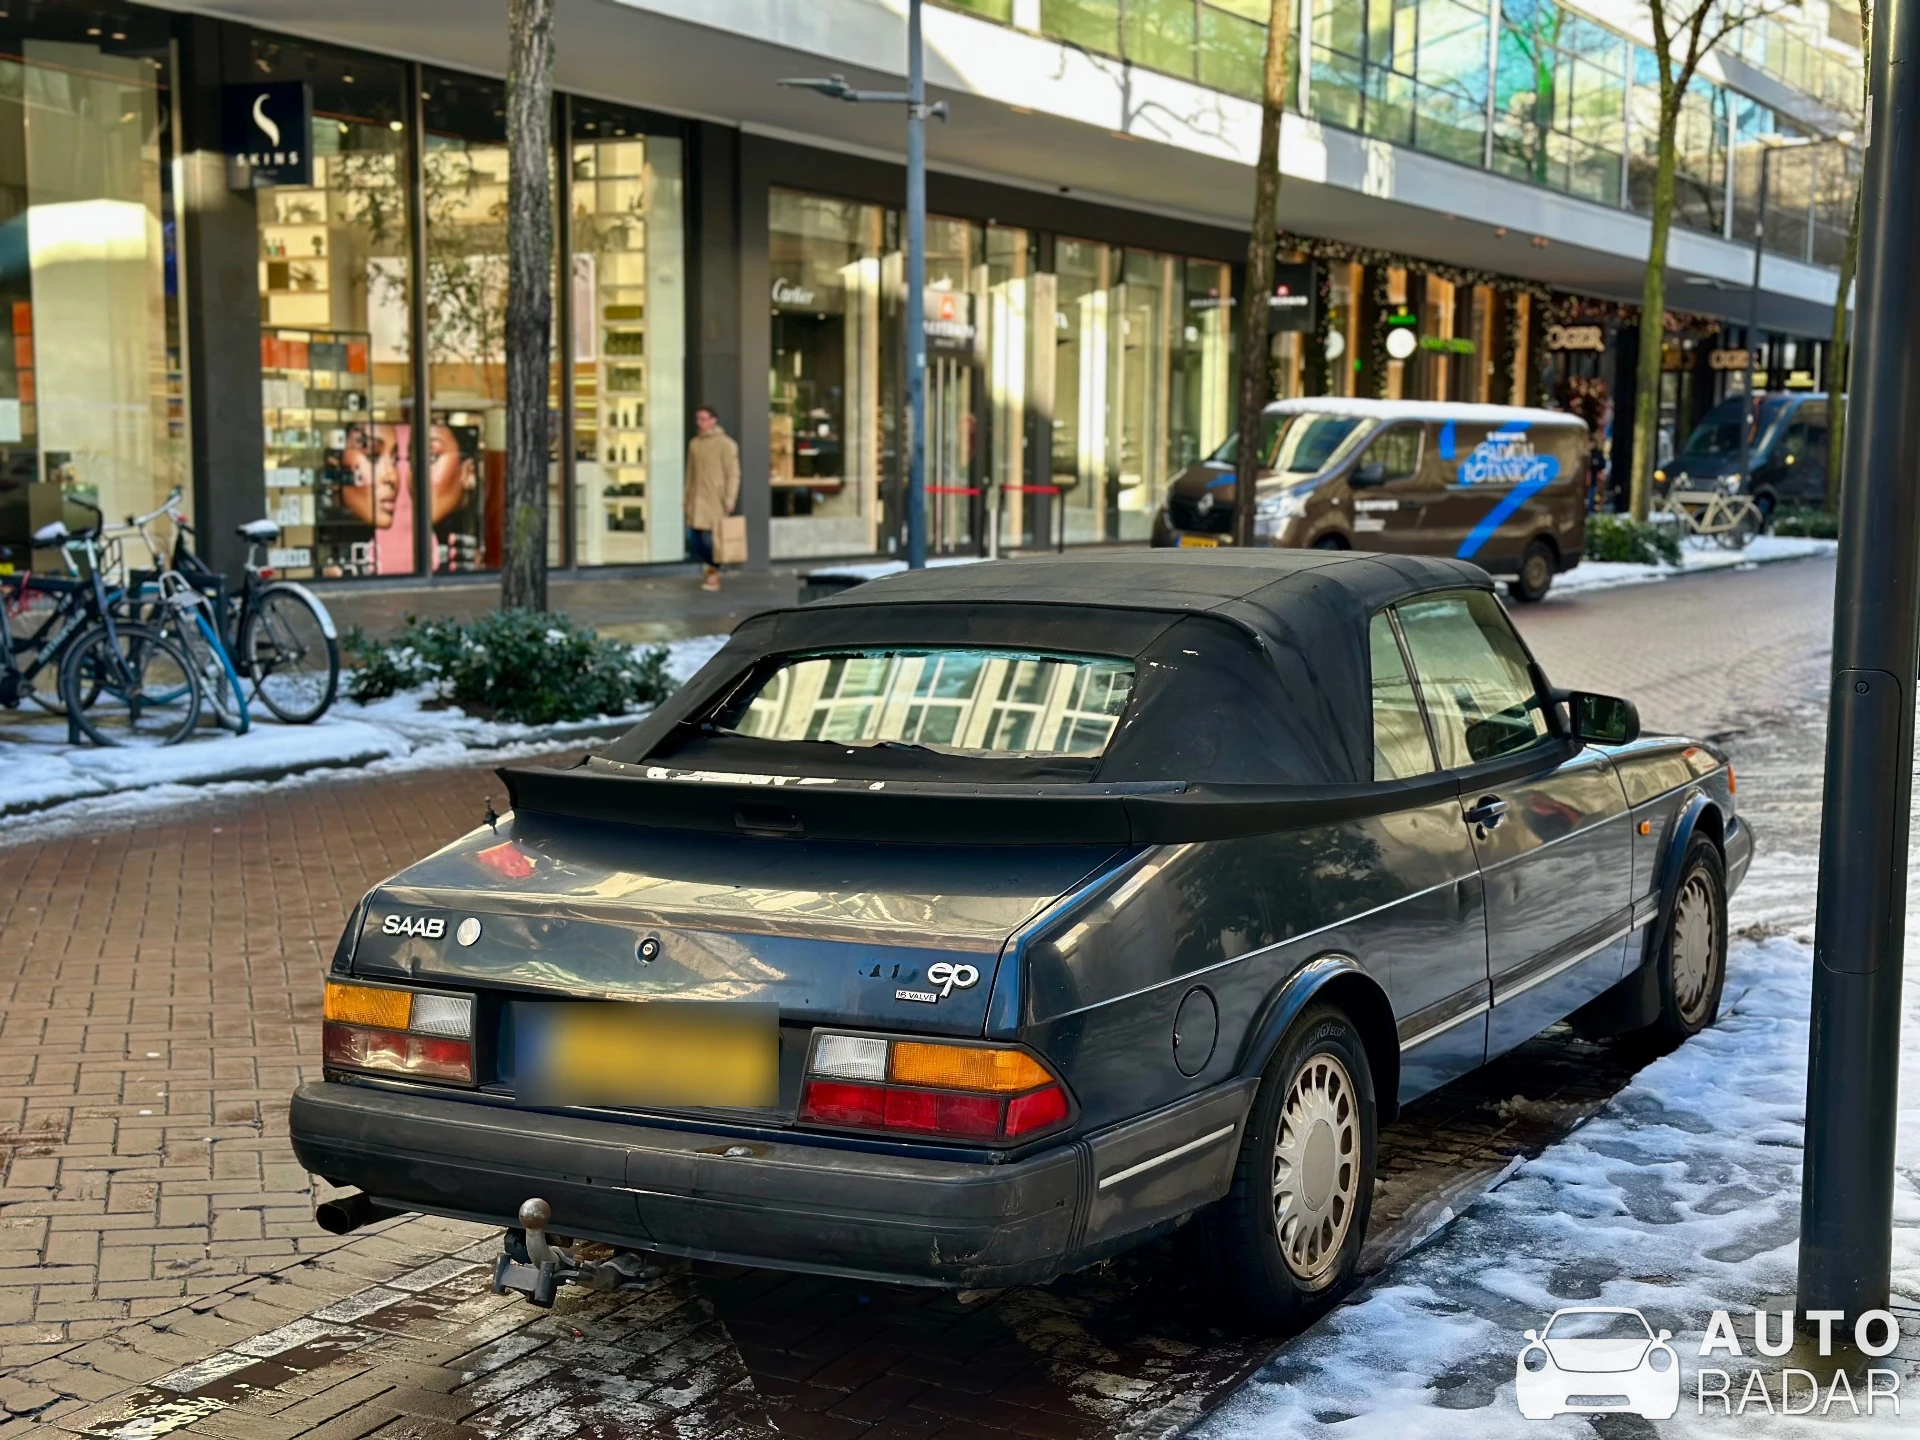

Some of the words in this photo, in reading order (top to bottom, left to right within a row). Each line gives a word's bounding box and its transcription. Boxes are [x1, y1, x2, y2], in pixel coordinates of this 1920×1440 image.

[236, 151, 299, 167] SKINS
[771, 277, 816, 305] Cartier
[1548, 325, 1605, 351] OGER
[382, 914, 446, 938] SAAB
[897, 990, 907, 999] 16
[908, 991, 936, 1002] VALVE
